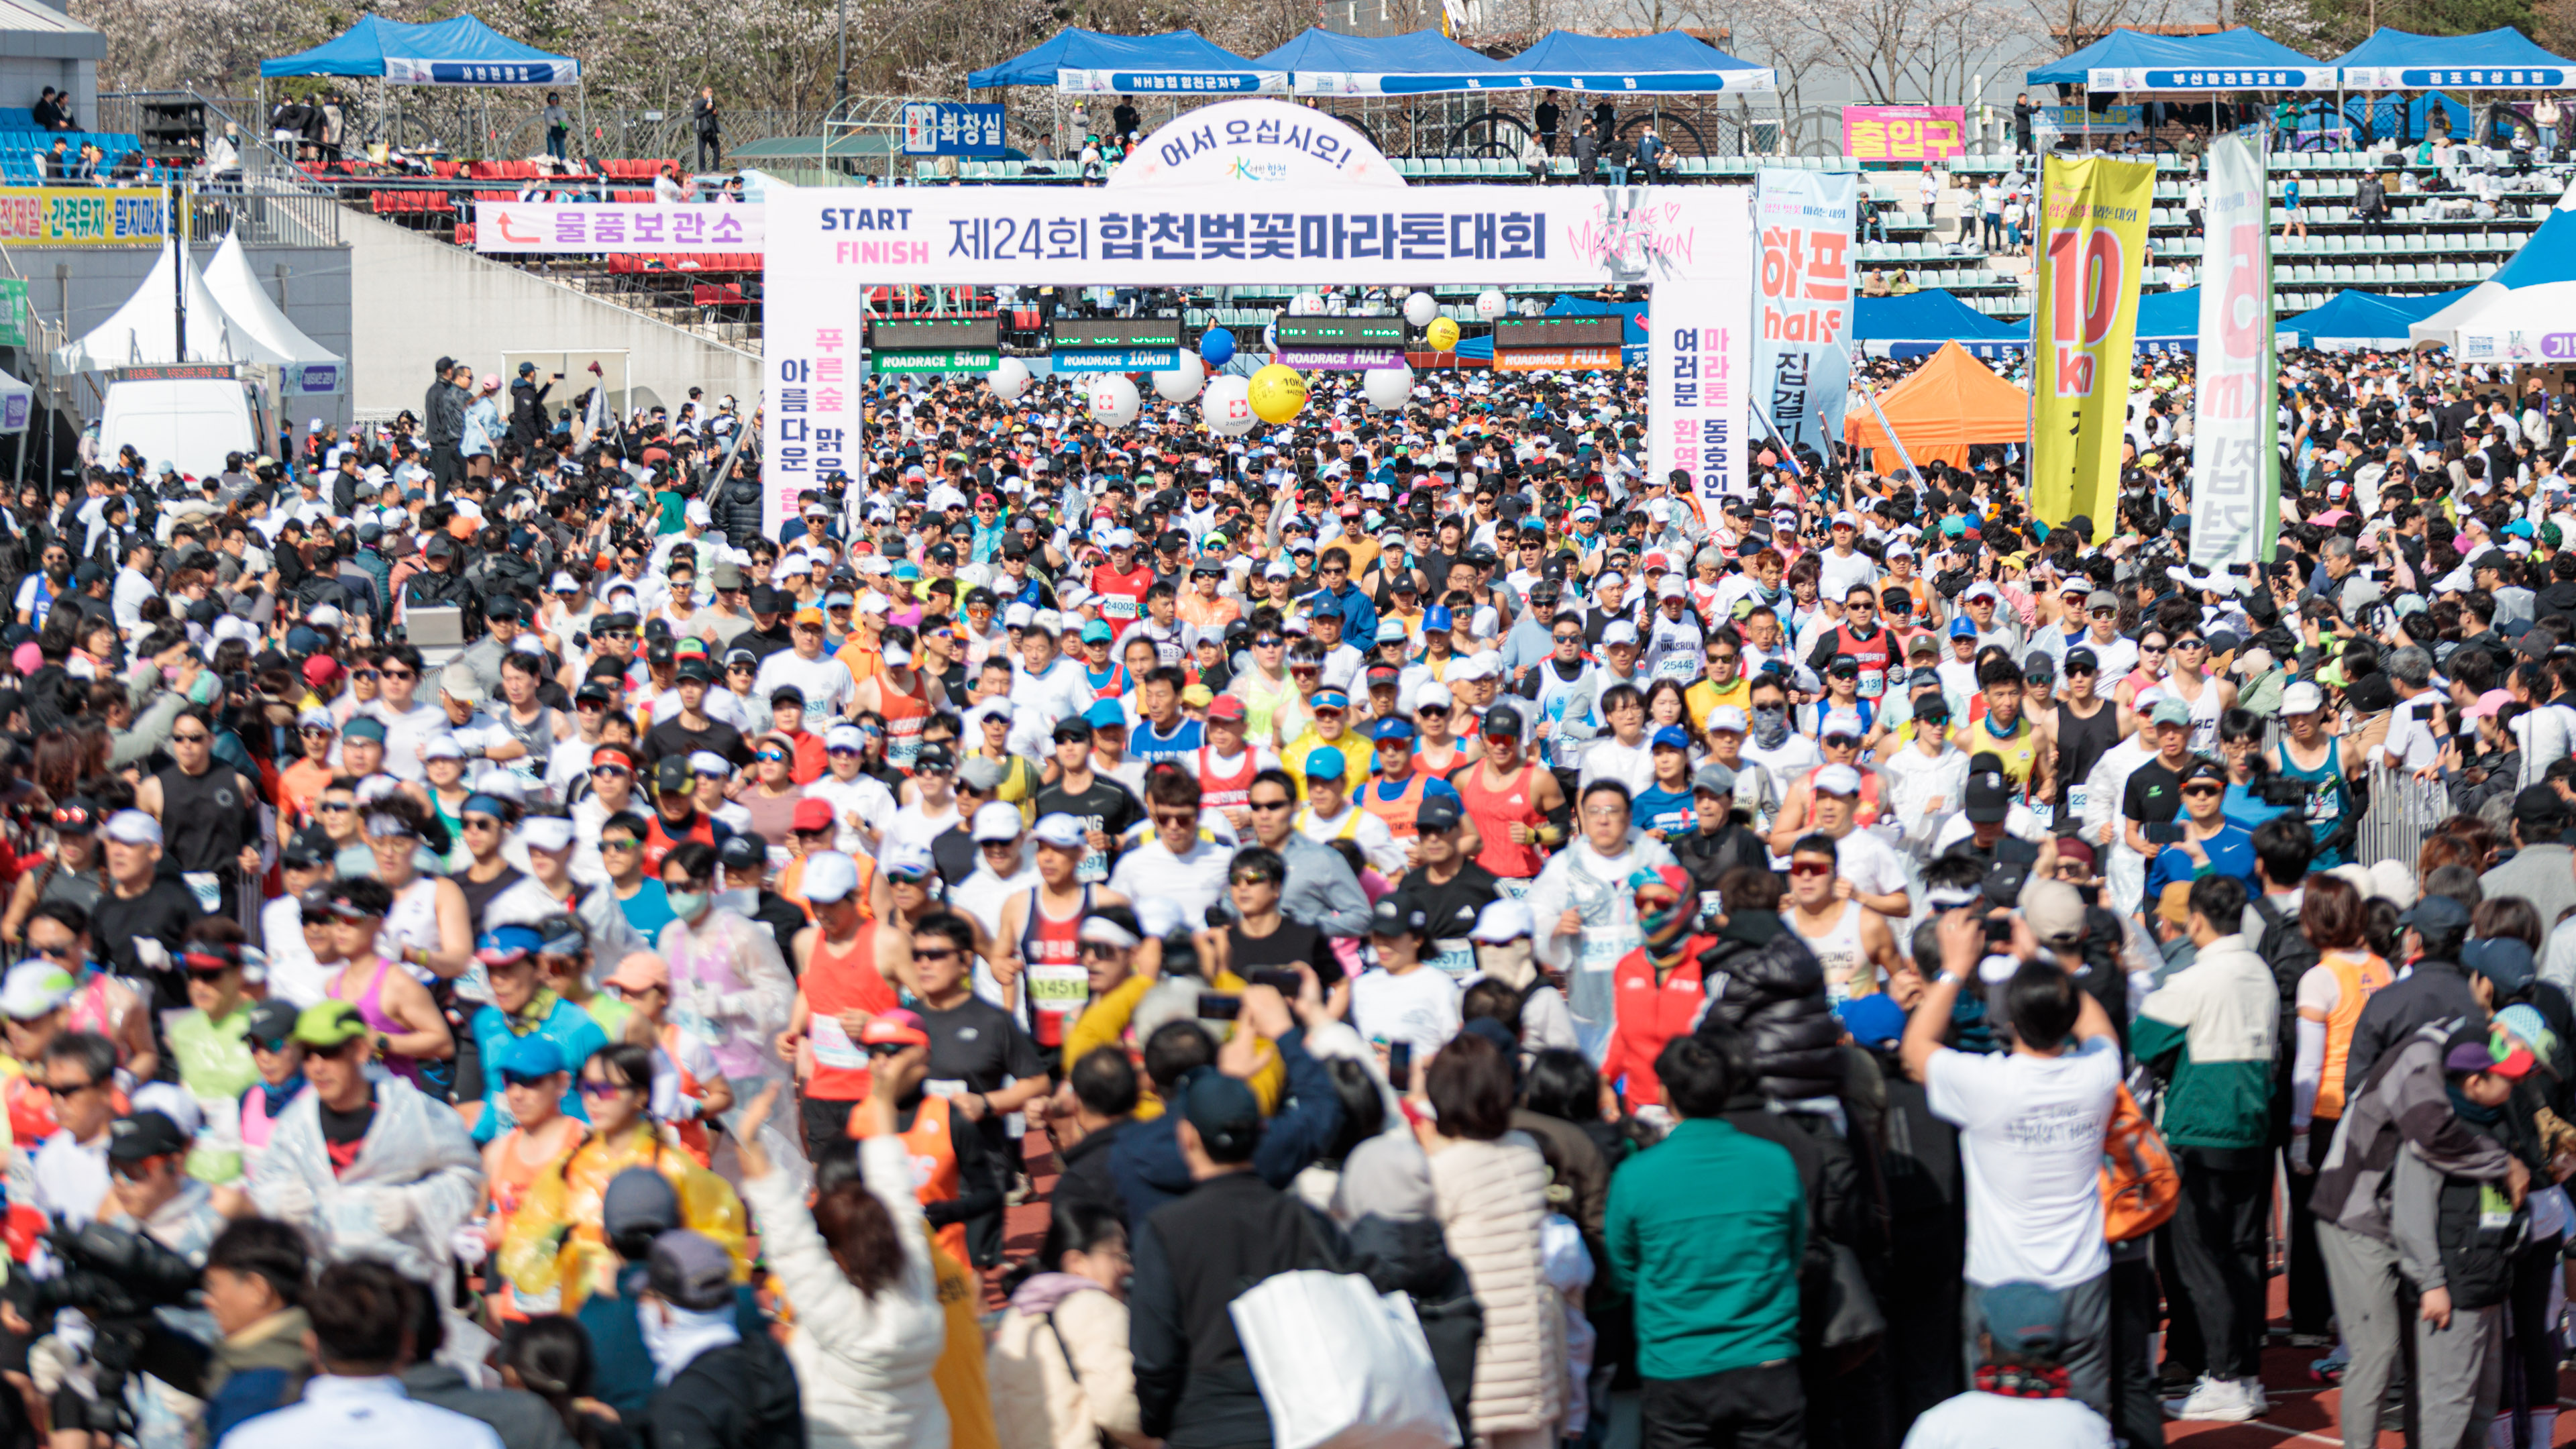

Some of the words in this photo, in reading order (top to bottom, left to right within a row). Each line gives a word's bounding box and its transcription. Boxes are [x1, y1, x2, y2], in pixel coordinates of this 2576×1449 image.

[1134, 76, 1177, 89] NH농협
[1181, 76, 1241, 89] 합천군지부
[2173, 73, 2286, 85] 부산마라톤교실
[2430, 72, 2544, 84] 김포육상클럽
[941, 113, 1001, 146] 화장실
[1161, 125, 1218, 167] 어서
[1226, 119, 1352, 170] 오십시오!
[1850, 119, 1960, 158] 출입구
[51, 197, 105, 237] 간격유지
[555, 212, 743, 244] 물품보관소
[821, 208, 912, 231] START
[1617, 204, 1658, 225] LOVE
[837, 241, 929, 264] FINISH
[949, 217, 1087, 260] 제24회
[1098, 212, 1546, 261] 합천벚꽃마라톤대회
[1568, 219, 1694, 268] MARATHON
[1762, 226, 1847, 301] 하프
[2048, 230, 2120, 343] 10
[1764, 305, 1841, 343] half
[816, 329, 843, 412] 푸른숲
[882, 356, 947, 368] ROADRACE
[954, 351, 990, 366] 5km
[1063, 355, 1122, 366] ROADRACE
[1128, 351, 1171, 366] 10km
[1287, 353, 1348, 364] ROADRACE
[1353, 349, 1396, 364] HALF
[1505, 354, 1566, 366] ROADRACE
[1572, 350, 1610, 365] FULL
[1674, 328, 1698, 407] 여러분
[1704, 328, 1729, 407] 마라톤
[781, 359, 810, 472] 아름다운
[1773, 353, 1809, 445] 집결지
[816, 429, 845, 497] 맑은
[1674, 419, 1699, 498] 환영
[1704, 419, 1728, 499] 동호인
[1106, 601, 1135, 612] 24002
[1660, 641, 1696, 651] UNISRUN
[1663, 660, 1694, 670] 25445
[2072, 794, 2088, 805] 23
